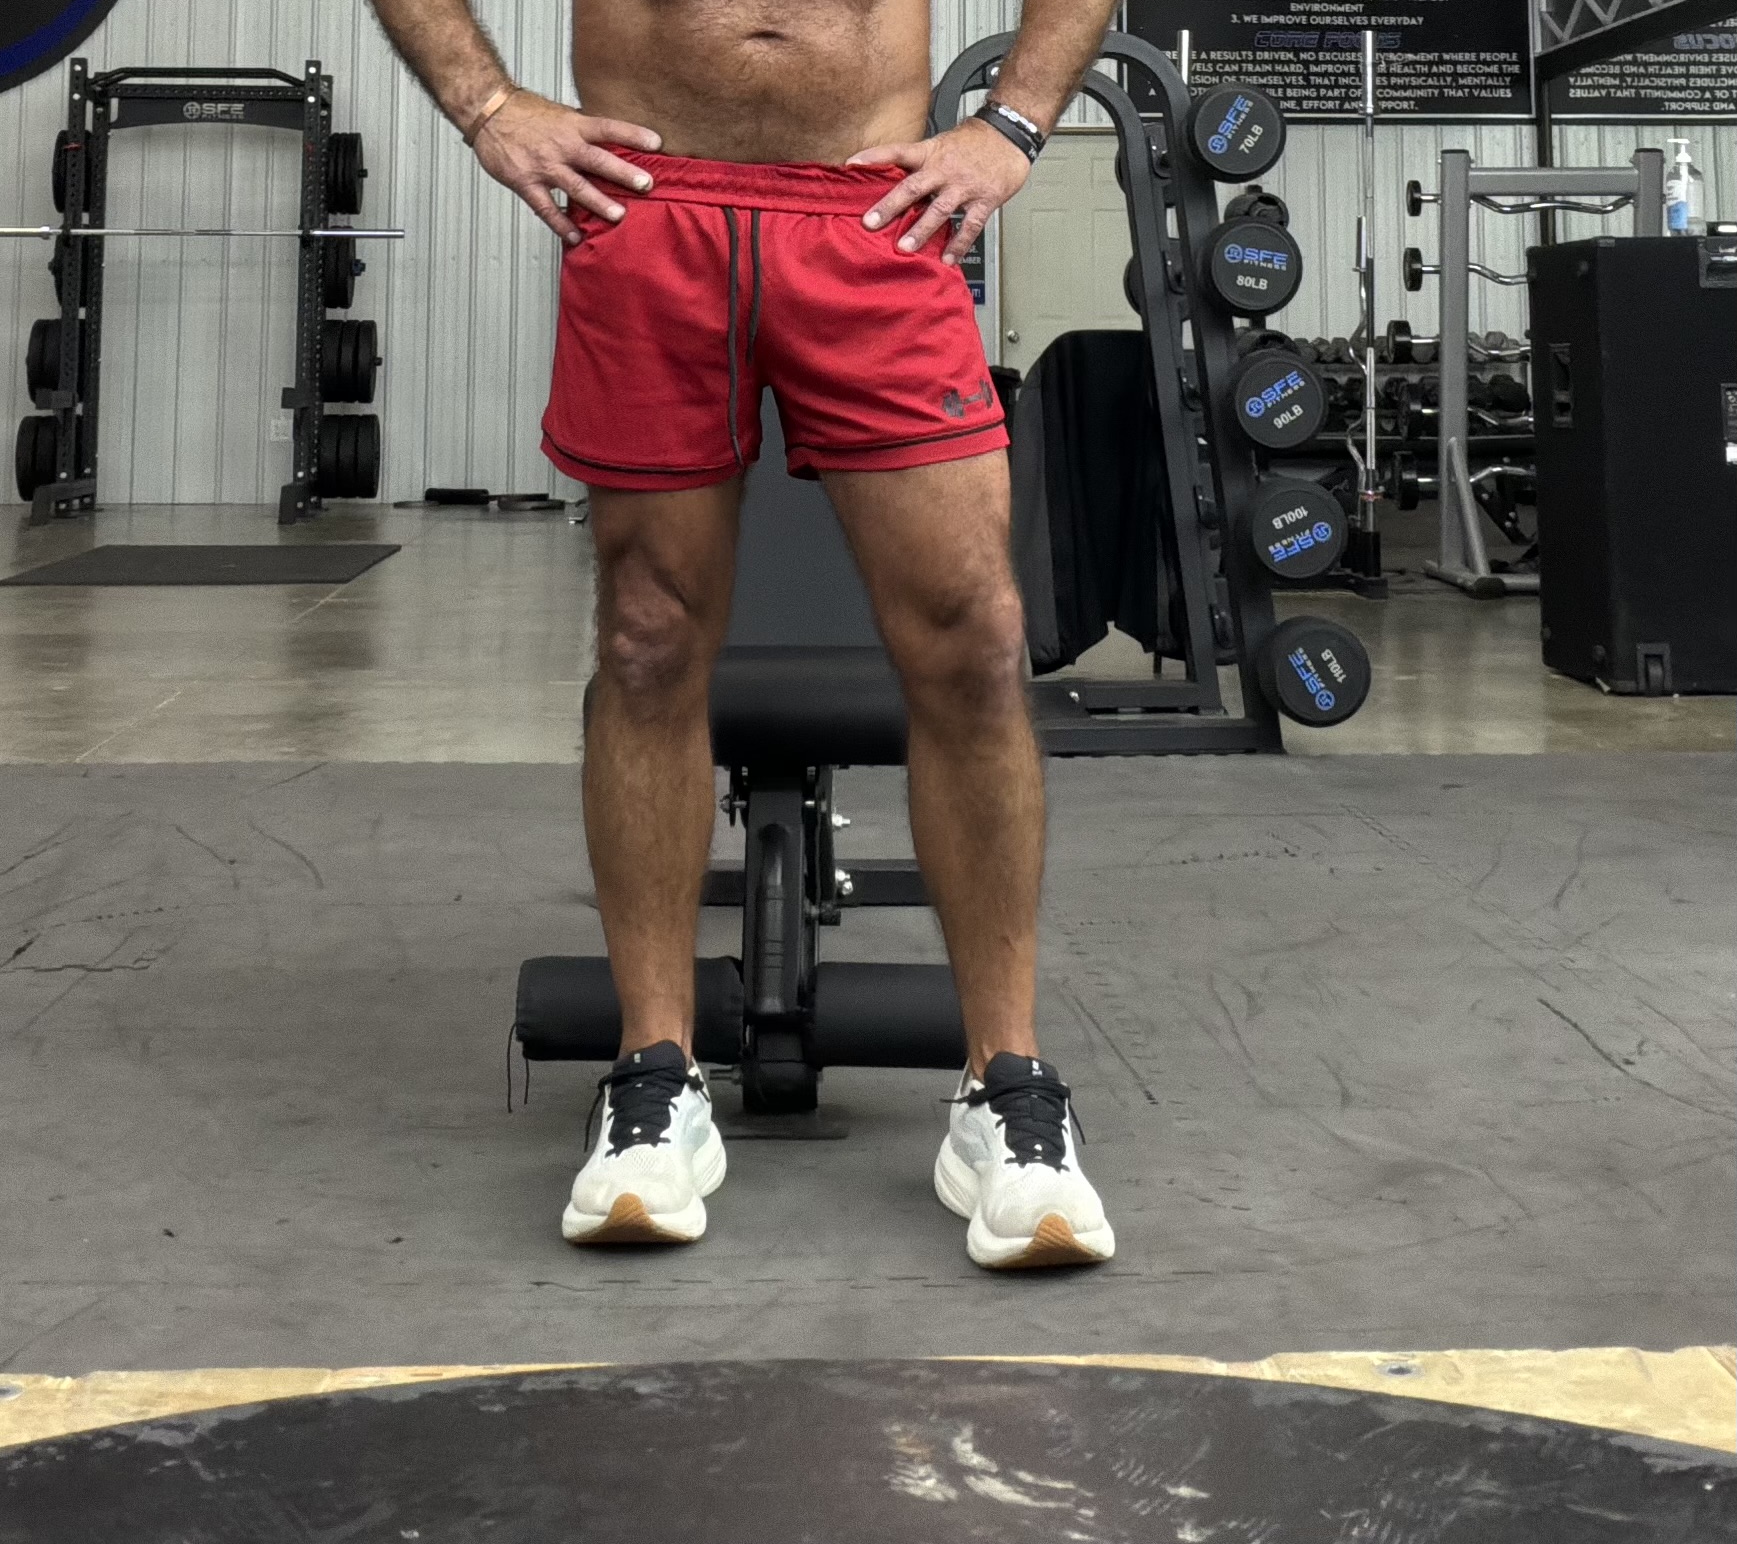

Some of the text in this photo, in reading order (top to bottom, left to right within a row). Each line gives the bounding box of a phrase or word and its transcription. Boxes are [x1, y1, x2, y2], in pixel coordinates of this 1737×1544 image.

[1290, 3, 1364, 12] ENVIRONMENT
[1230, 14, 1424, 26] 3. WE IMPROVE OURSELVES EVERYDAY
[1200, 51, 1208, 59] A
[1210, 51, 1253, 60] RESULTS
[1256, 51, 1297, 62] DRIVEN,
[1300, 52, 1316, 61] NO
[1318, 52, 1363, 61] EXCUSES
[1443, 53, 1477, 62] WHERE
[1479, 53, 1518, 62] PEOPLE
[1216, 63, 1239, 73] CAN
[1241, 64, 1272, 73] TRAIN
[1274, 64, 1307, 74] HARD,
[1309, 64, 1356, 74] IMPROVE
[1389, 65, 1428, 74] HEALTH
[1431, 65, 1454, 74] AND
[1456, 65, 1501, 74] BECOME
[1503, 65, 1520, 74] THE
[1309, 77, 1335, 85] THAT
[1338, 77, 1388, 86] INCLES
[1390, 77, 1457, 87] PHYSICALLY,
[1458, 77, 1511, 86] MENTALLY
[1286, 88, 1316, 97] BEING
[1320, 88, 1347, 97] PART
[1349, 89, 1362, 97] OF
[1376, 89, 1439, 98] COMMUNITY
[1443, 89, 1469, 98] THAT
[1472, 89, 1512, 98] VALUES
[201, 103, 245, 114] SFE
[1302, 101, 1339, 110] EFFORT
[1218, 95, 1246, 136] SFE
[1239, 124, 1263, 154] 70LB
[1244, 247, 1288, 265] SFE
[1236, 275, 1268, 290] 80LB
[1261, 370, 1302, 403] SFE
[1273, 404, 1304, 429] 90LB
[1272, 505, 1309, 530] 100LB
[1271, 534, 1315, 563] SFE
[1288, 650, 1320, 695] SFE
[1321, 648, 1347, 684] 110LB
